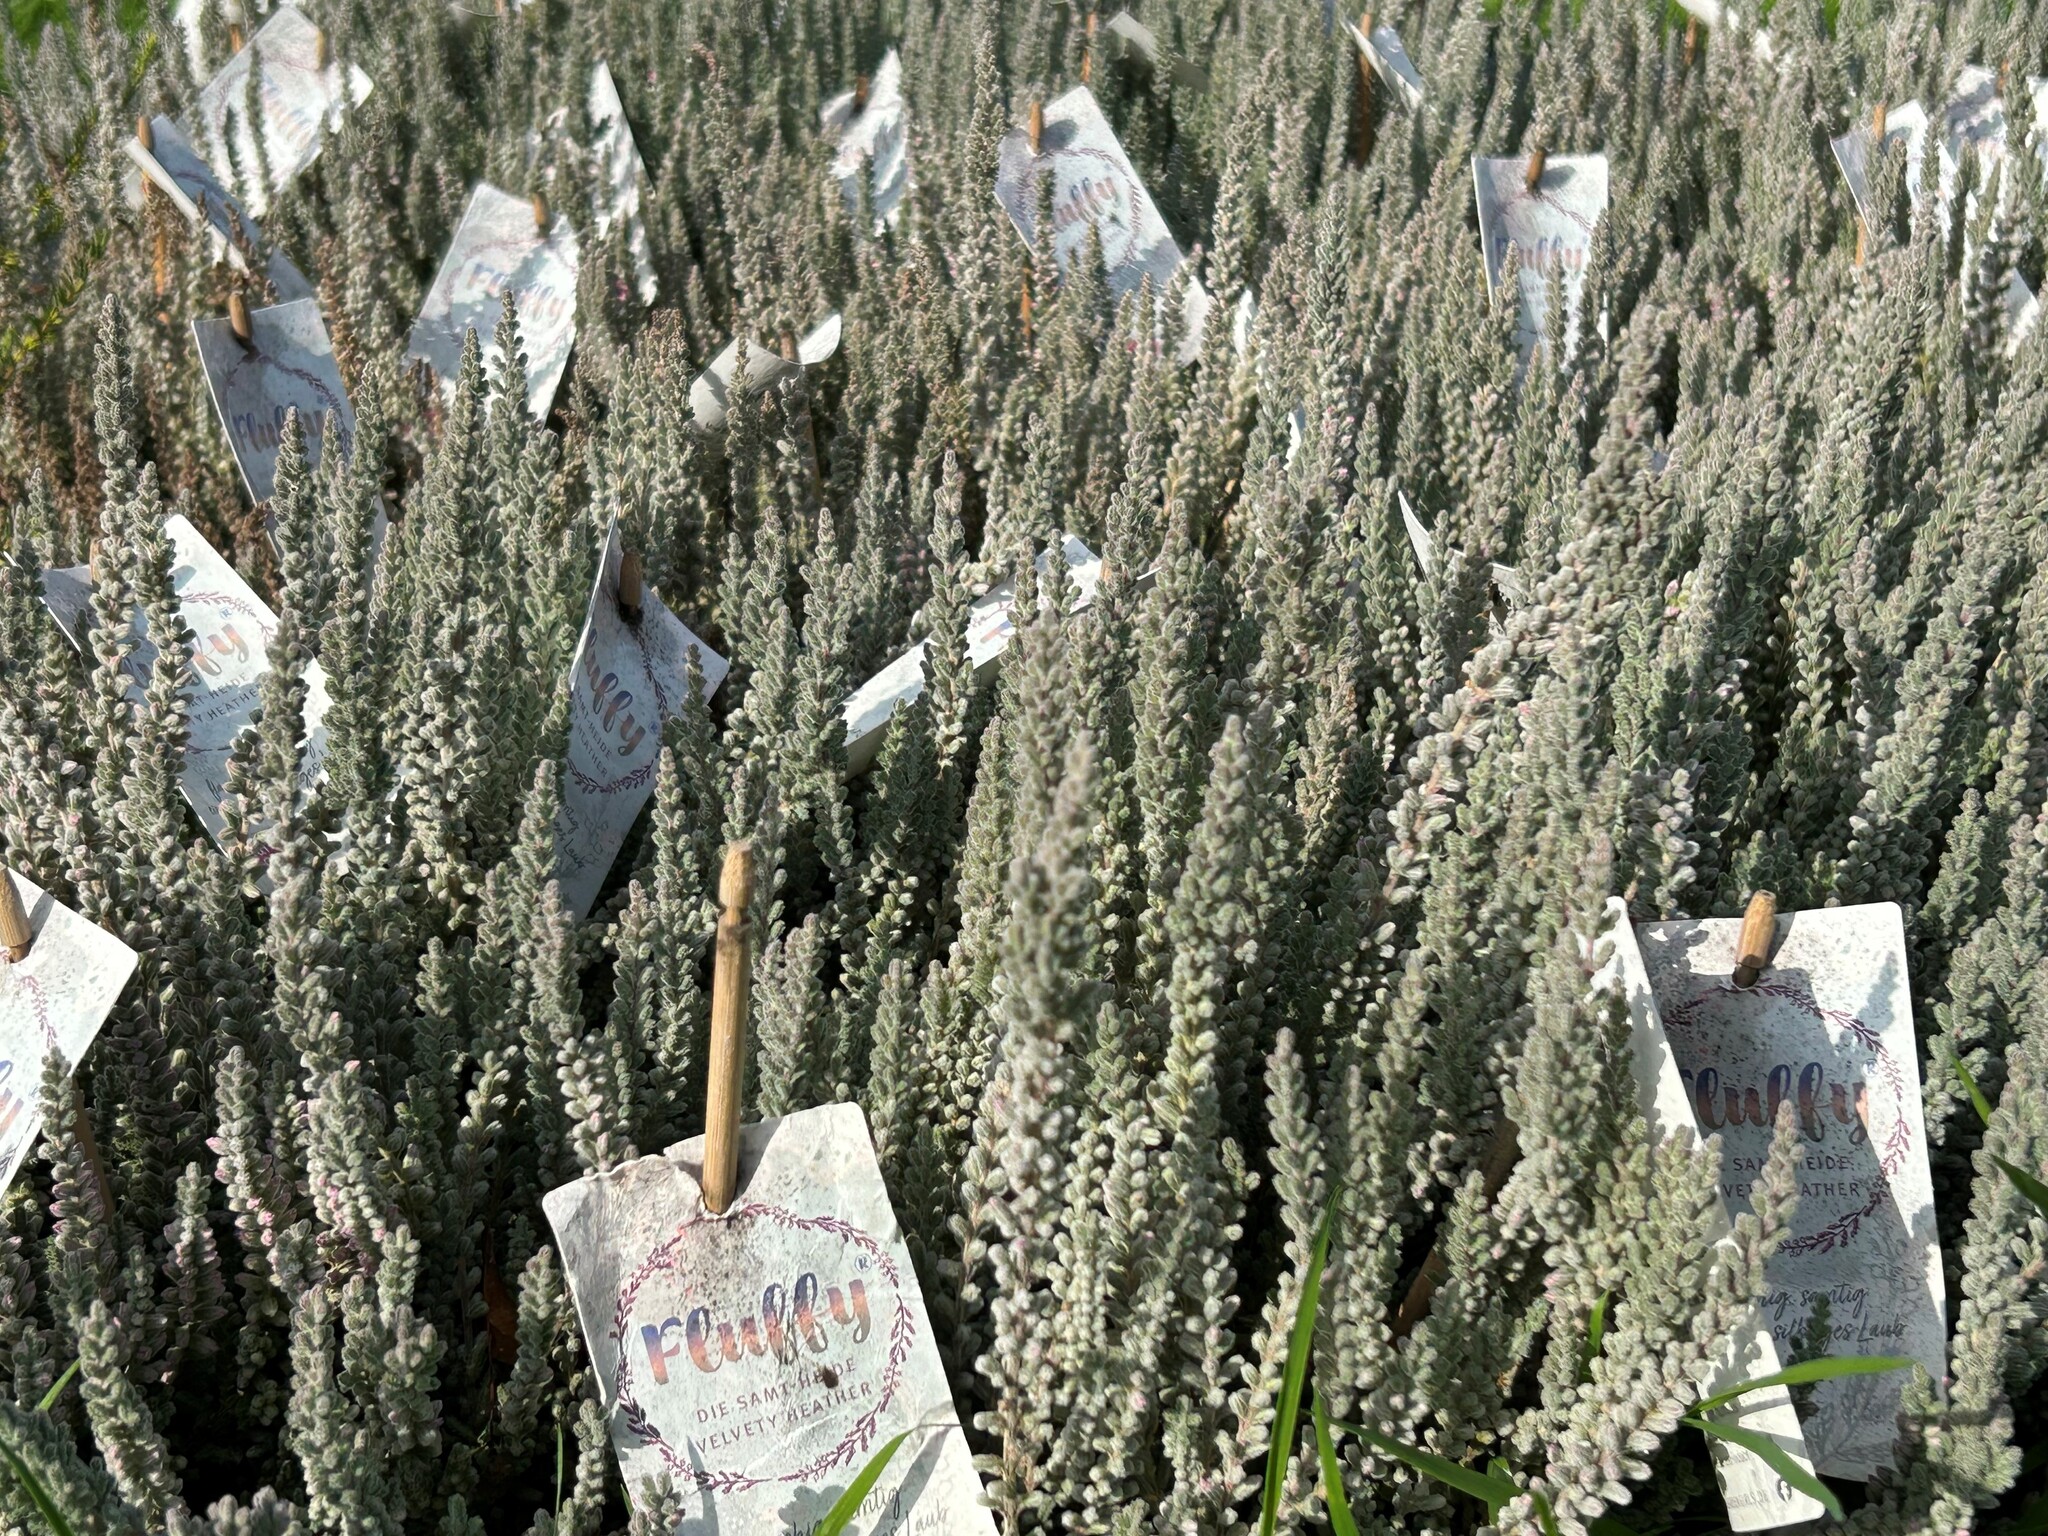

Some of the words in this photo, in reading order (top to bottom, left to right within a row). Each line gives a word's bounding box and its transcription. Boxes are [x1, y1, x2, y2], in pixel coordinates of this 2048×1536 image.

[584, 628, 646, 756] luffy
[1680, 1062, 1869, 1145] luffy
[1801, 1182, 1862, 1198] ATHER
[640, 1271, 872, 1386] Fluffy
[696, 1401, 730, 1424] DIE
[736, 1357, 857, 1411] SAMT-HEDE
[696, 1414, 777, 1455] VELVETY
[787, 1381, 873, 1423] HEATHER
